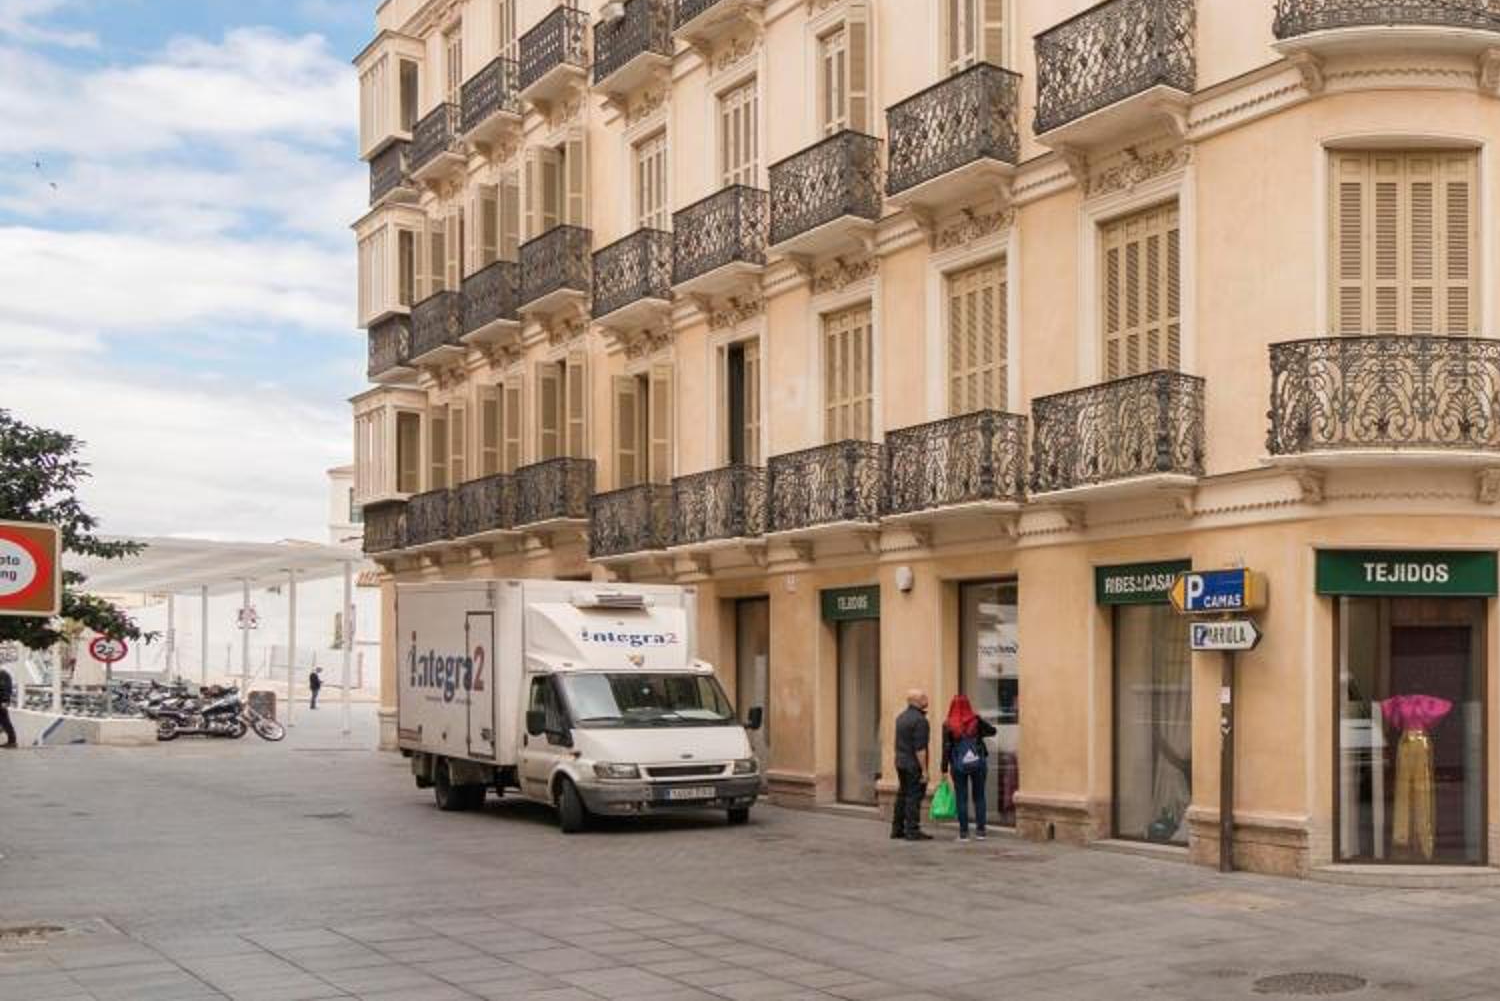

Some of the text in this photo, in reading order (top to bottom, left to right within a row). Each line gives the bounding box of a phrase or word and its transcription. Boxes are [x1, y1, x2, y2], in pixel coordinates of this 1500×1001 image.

[1363, 562, 1449, 583] TEJIDOS
[1187, 575, 1242, 610] P CAMAS
